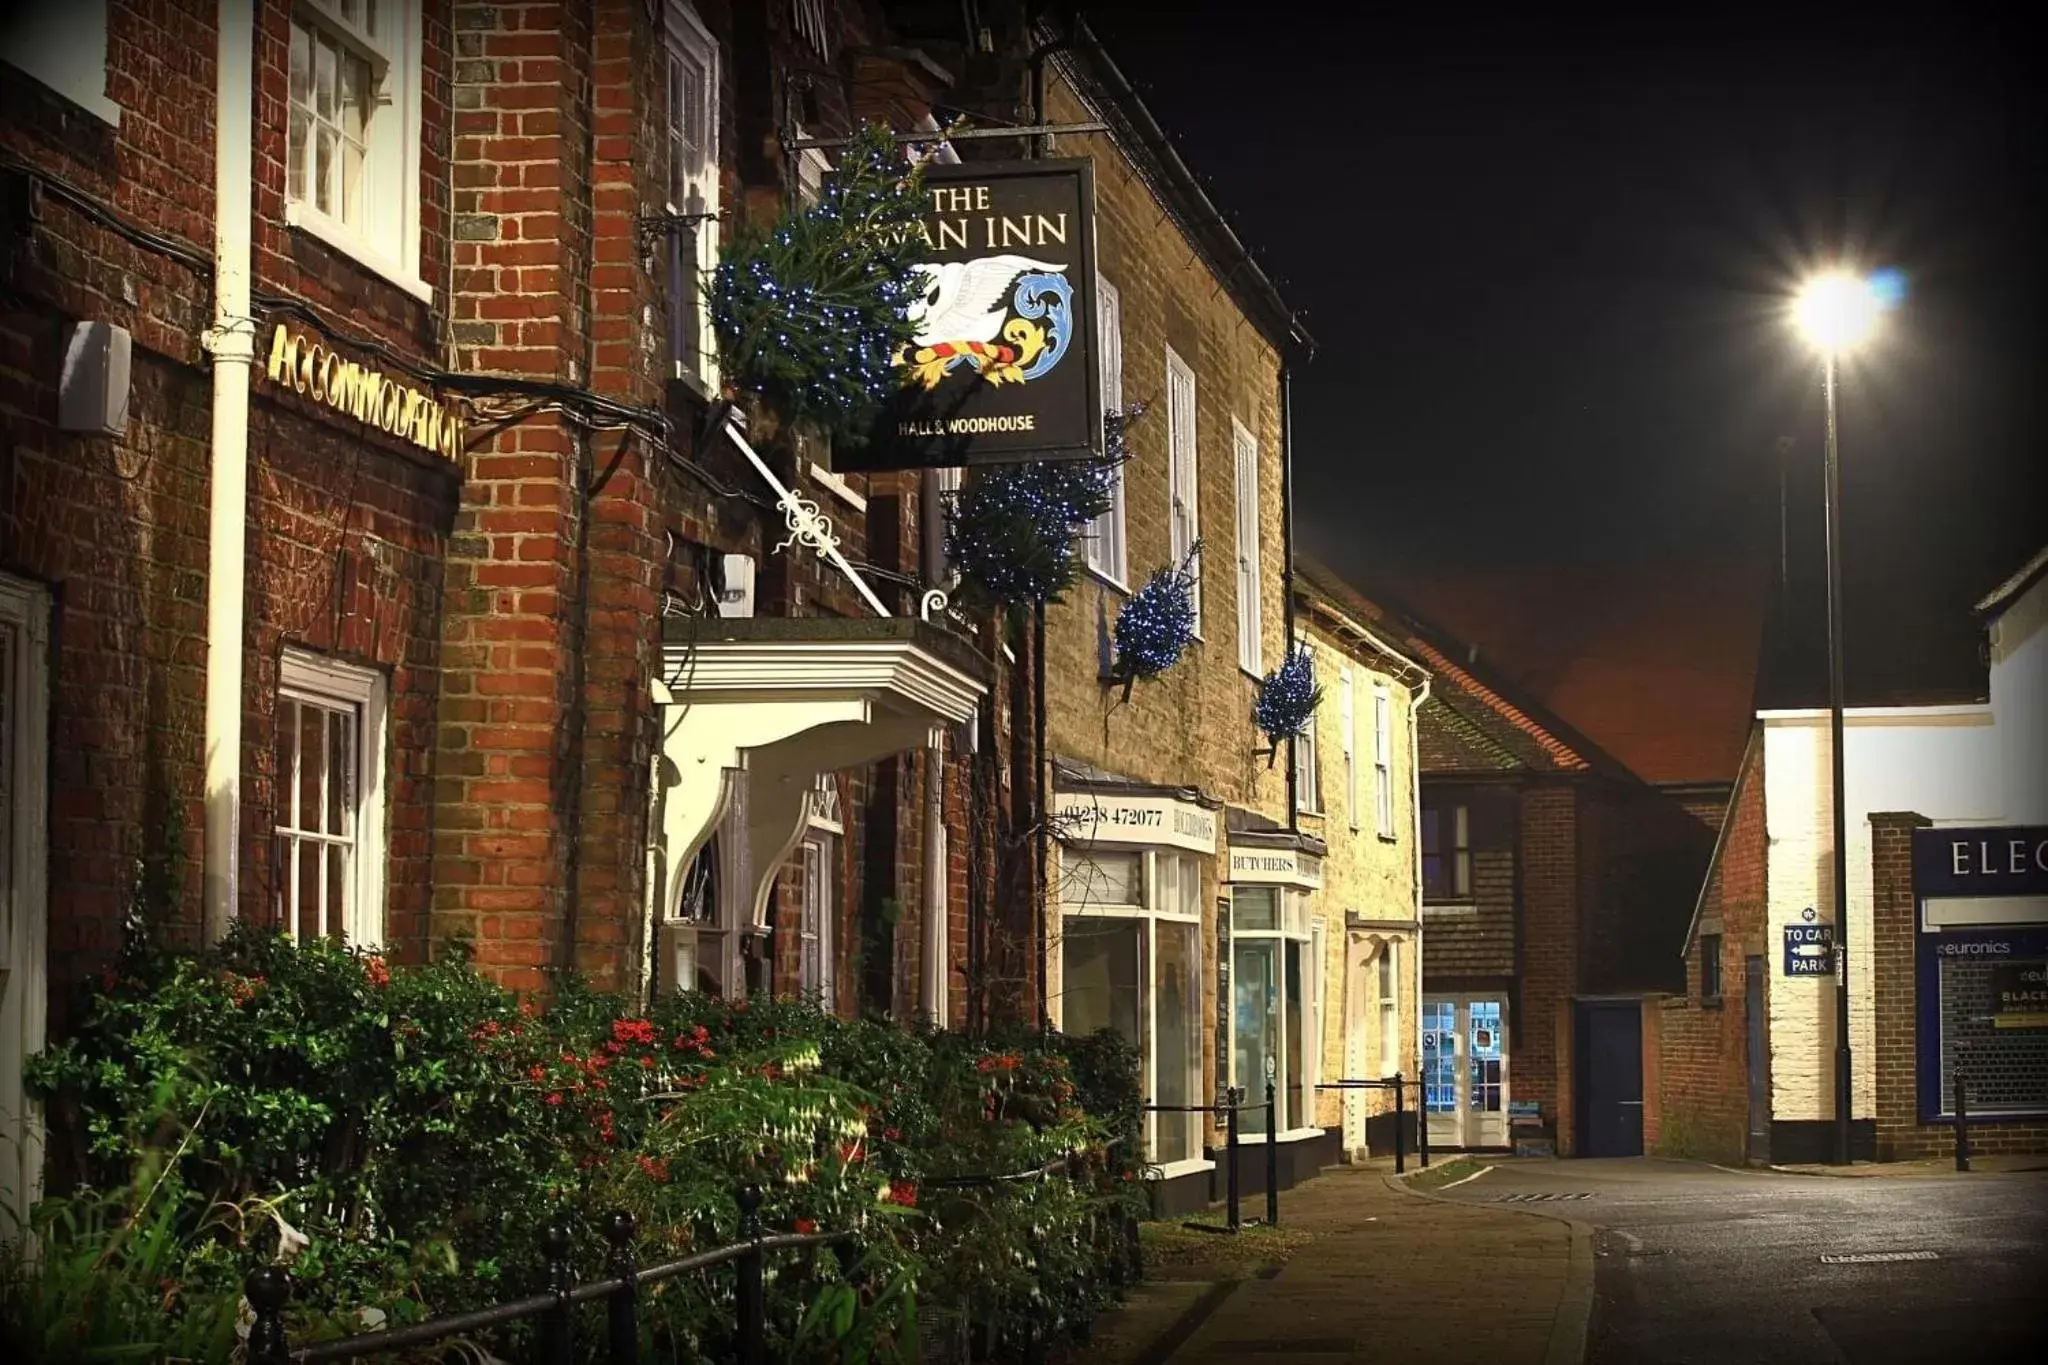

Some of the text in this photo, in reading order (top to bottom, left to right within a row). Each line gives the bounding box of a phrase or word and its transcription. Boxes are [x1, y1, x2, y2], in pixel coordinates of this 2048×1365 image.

[931, 186, 991, 213] THE
[985, 213, 1067, 249] INN
[898, 419, 934, 436] HALL
[946, 415, 1035, 434] WOODHOUSE
[1111, 806, 1163, 827] 472077
[1233, 855, 1294, 872] BUTCHERS
[1785, 928, 1832, 942] TO CAR
[1945, 940, 2011, 955] euronics
[1791, 958, 1828, 972] PARK
